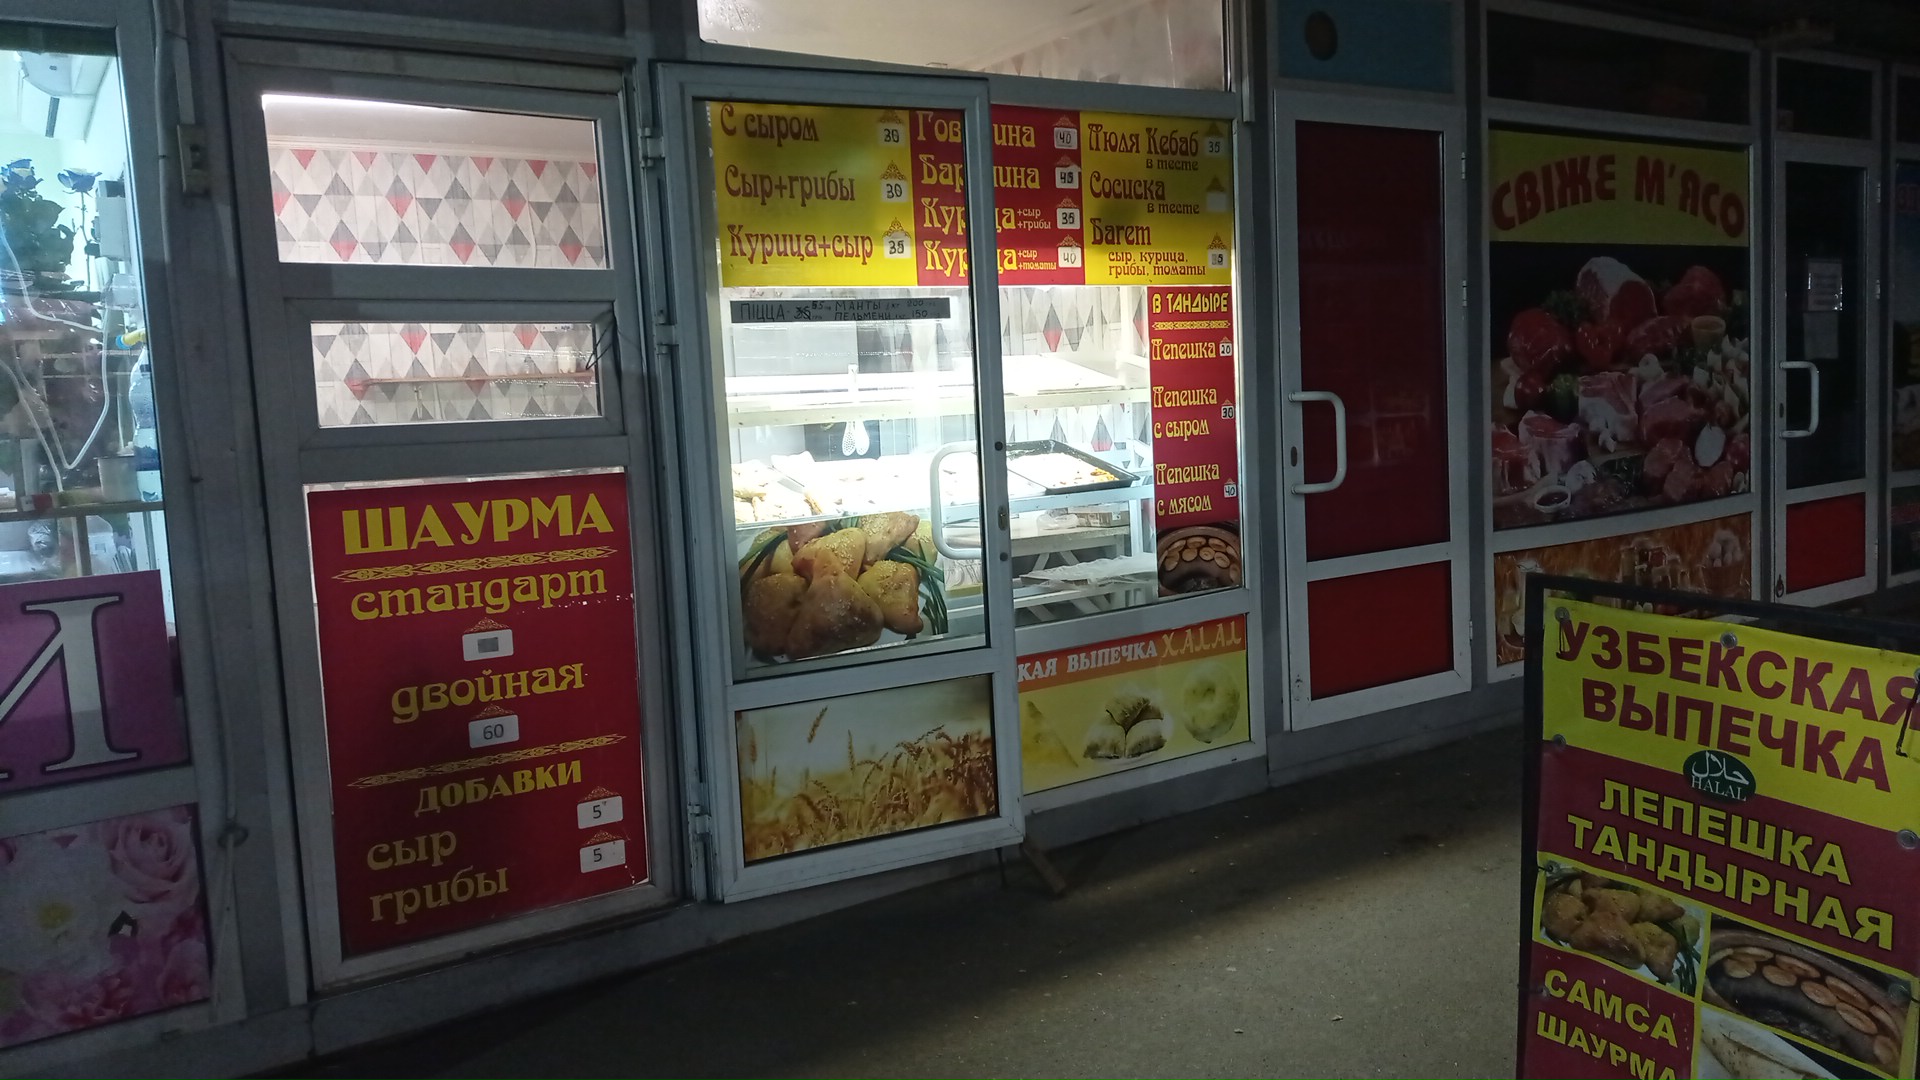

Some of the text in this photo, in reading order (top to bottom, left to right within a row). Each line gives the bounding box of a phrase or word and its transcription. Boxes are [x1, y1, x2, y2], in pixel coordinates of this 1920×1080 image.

[720, 103, 820, 147] С сыром
[883, 127, 900, 143] 30
[916, 110, 1036, 148] Говина
[1059, 131, 1072, 145] 40
[1145, 127, 1199, 157] Кебаб
[918, 153, 1041, 193] Барина
[1145, 159, 1199, 171] в тесте
[724, 164, 856, 208] Сыр+грибы
[886, 182, 902, 199] 30
[1089, 170, 1166, 201] Сосиска
[1491, 153, 1745, 238] СВІЖЕ М'ЯСО
[1017, 207, 1041, 220] +сыр
[1146, 203, 1200, 214] в тесте
[1017, 219, 1052, 231] +грибы
[1089, 217, 1152, 246] Багет
[726, 223, 874, 265] Курица+сыр
[888, 238, 905, 255] 35
[1018, 249, 1038, 260] +сыр
[1018, 261, 1057, 270] +томаты
[1063, 252, 1076, 264] 40
[1153, 264, 1206, 276] томаты
[740, 302, 786, 322] ПІЦЦА
[834, 300, 881, 311] МАНТЫ
[1152, 292, 1229, 314] В ТАНДЫРЕ
[834, 311, 891, 321] ПЕЛЬМЕНИ
[1151, 337, 1217, 361] Лепешка
[1152, 385, 1218, 408] Лепешка
[1153, 419, 1210, 442] с сыром
[1155, 463, 1220, 486] Лепешка
[1156, 494, 1212, 516] с мясом
[341, 493, 614, 555] ШАУРМА
[350, 568, 608, 621] стандарт
[1066, 641, 1158, 673] ВЫПЕЧКА
[1556, 618, 1920, 732] УЗБЕКСКАЯ
[391, 662, 585, 725] двойная
[483, 723, 504, 740] 60
[1581, 677, 1892, 793] ВЫПЕЧКА
[414, 759, 582, 818] ДОБАВКИ
[1691, 775, 1747, 801] HALAL
[592, 804, 602, 819] 5
[1599, 777, 1852, 886] ЛЕПЕШКА
[366, 829, 457, 871] сыр
[593, 847, 603, 863] 5
[1566, 814, 1894, 951] ТАНДЫРНАЯ
[369, 865, 509, 924] грибы
[1544, 969, 1678, 1048] САМСА
